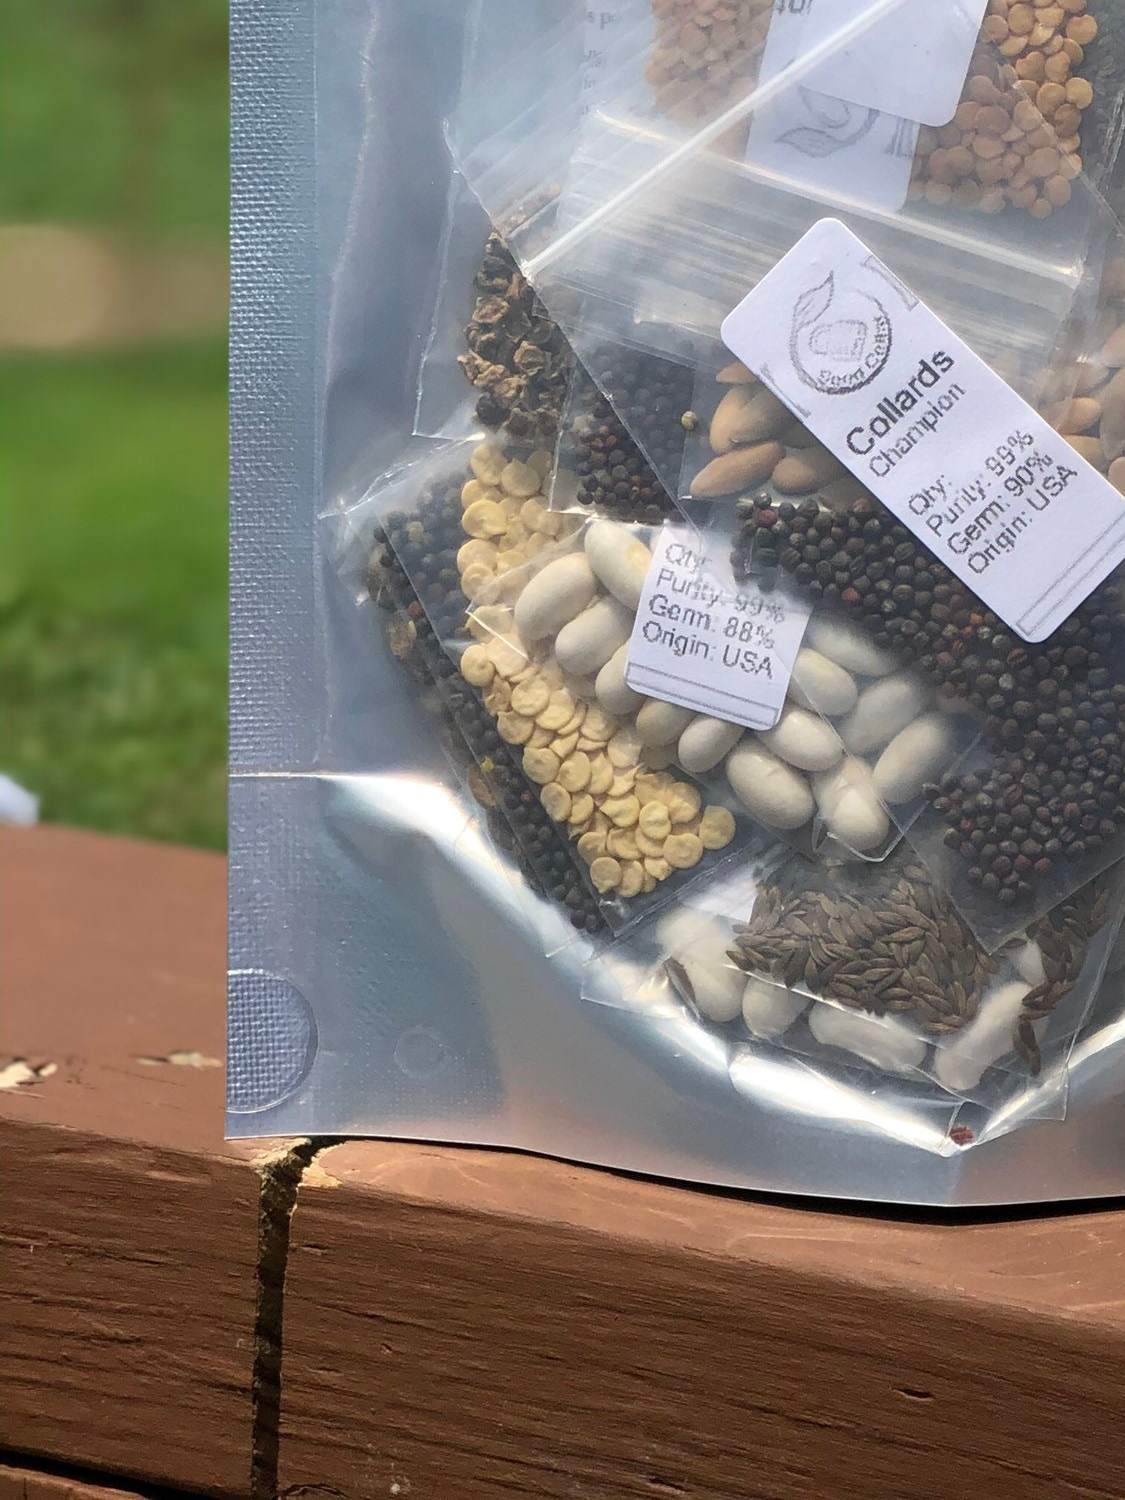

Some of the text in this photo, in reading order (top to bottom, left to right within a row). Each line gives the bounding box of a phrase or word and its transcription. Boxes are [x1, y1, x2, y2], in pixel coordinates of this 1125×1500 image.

[846, 350, 955, 455] Collards
[869, 382, 966, 478] Champion
[908, 474, 953, 516] Qty:
[925, 430, 1034, 538] Purity: 99%
[1004, 451, 1054, 498] 90%
[967, 465, 1078, 574] Origin: USA
[642, 621, 773, 680] Origin: USA
[723, 616, 775, 650] 88%
